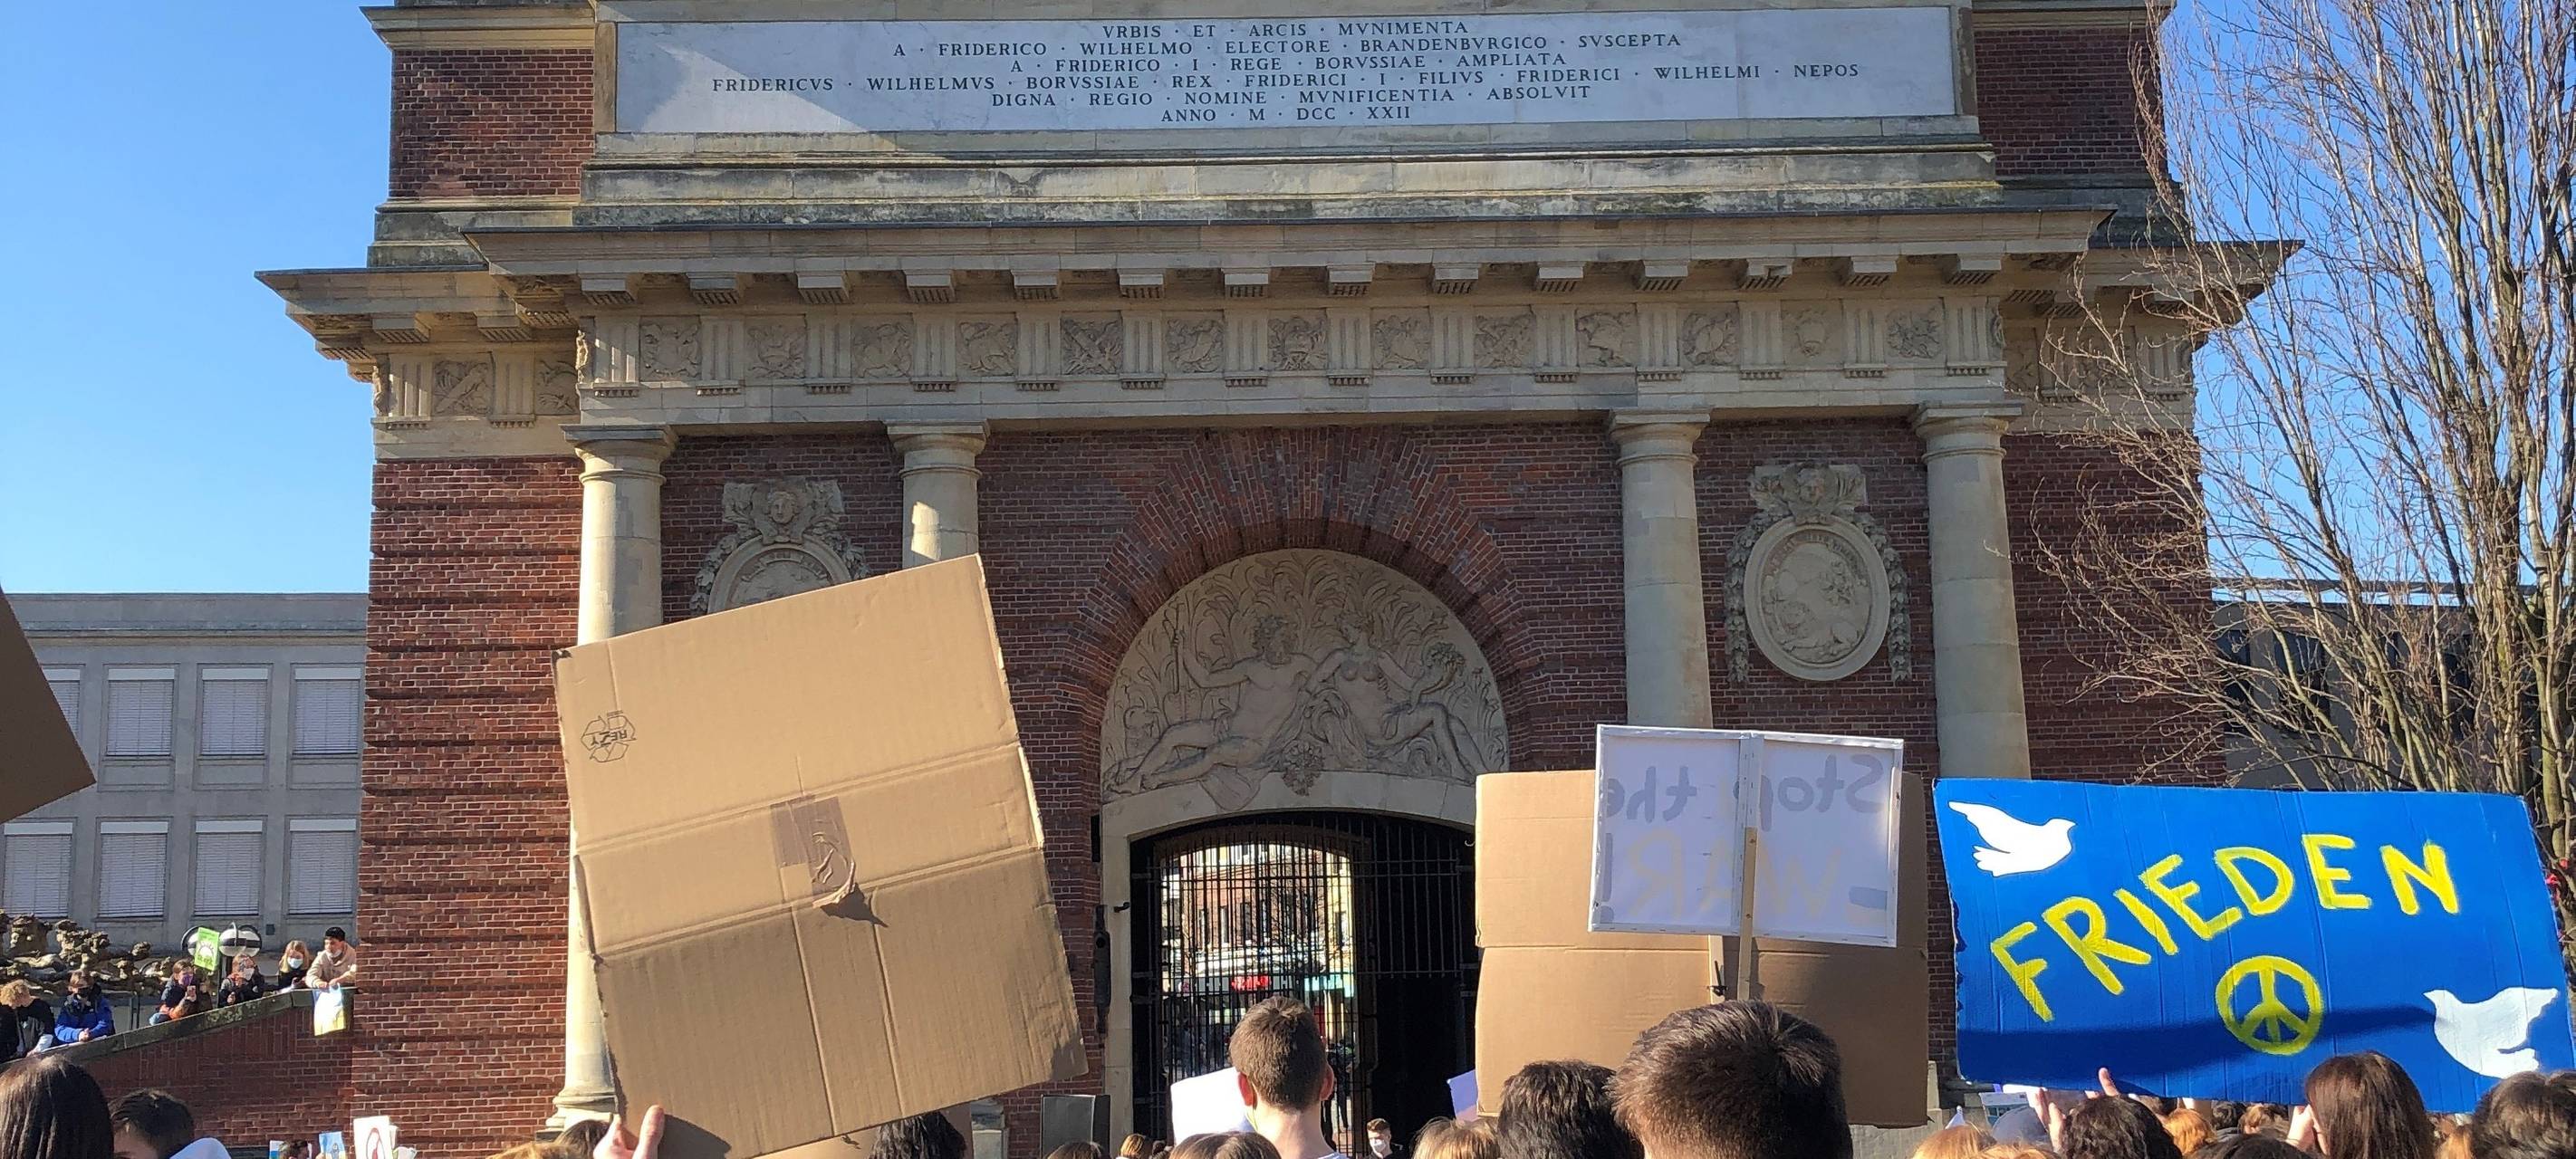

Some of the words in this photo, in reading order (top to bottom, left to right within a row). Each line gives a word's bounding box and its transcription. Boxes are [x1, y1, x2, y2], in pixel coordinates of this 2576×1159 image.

[1103, 25, 1161, 38] VRBIS
[1194, 25, 1216, 37] ET
[1249, 24, 1306, 36] ARCIS
[1339, 22, 1468, 35] MVNIMENTA
[893, 43, 906, 56] A
[938, 43, 1046, 56] FRIDERICO
[1081, 42, 1192, 55] WILHELMO
[1226, 40, 1331, 53] ELECTORE
[1360, 37, 1546, 53] BRANDENBVRGICO
[1579, 34, 1680, 48] SVSCEPTA
[1011, 60, 1023, 72] A
[1056, 59, 1160, 72] FRIDERICO
[1192, 58, 1198, 71] I
[1231, 58, 1282, 71] REGE
[1316, 55, 1425, 69] BORVSSIAE
[1456, 53, 1566, 67] AMPLIATA
[713, 78, 833, 91] FRIDERICVS
[867, 77, 995, 91] WILHELMVS
[1027, 76, 1139, 89] BORVSSIAE
[1172, 75, 1212, 88] REX
[1245, 73, 1346, 87] FRIDERICI
[1379, 73, 1386, 85] I
[1419, 71, 1483, 84] FILIVS
[1517, 68, 1620, 82] FRIDERICI
[1655, 65, 1760, 80] WILHELMI
[1794, 64, 1859, 77] NEPOS
[993, 94, 1055, 107] DIGNA
[1090, 93, 1152, 106] REGIO
[1186, 91, 1266, 105] NOMINE
[1300, 89, 1454, 103] MVNIFICENTIA
[1487, 85, 1591, 100] ABSOLVIT
[1161, 109, 1216, 121] ANNO
[1249, 109, 1264, 120] M
[1297, 108, 1335, 120] DCC
[1368, 106, 1409, 120] XXII
[1990, 833, 2460, 1022] FRIEDEN
